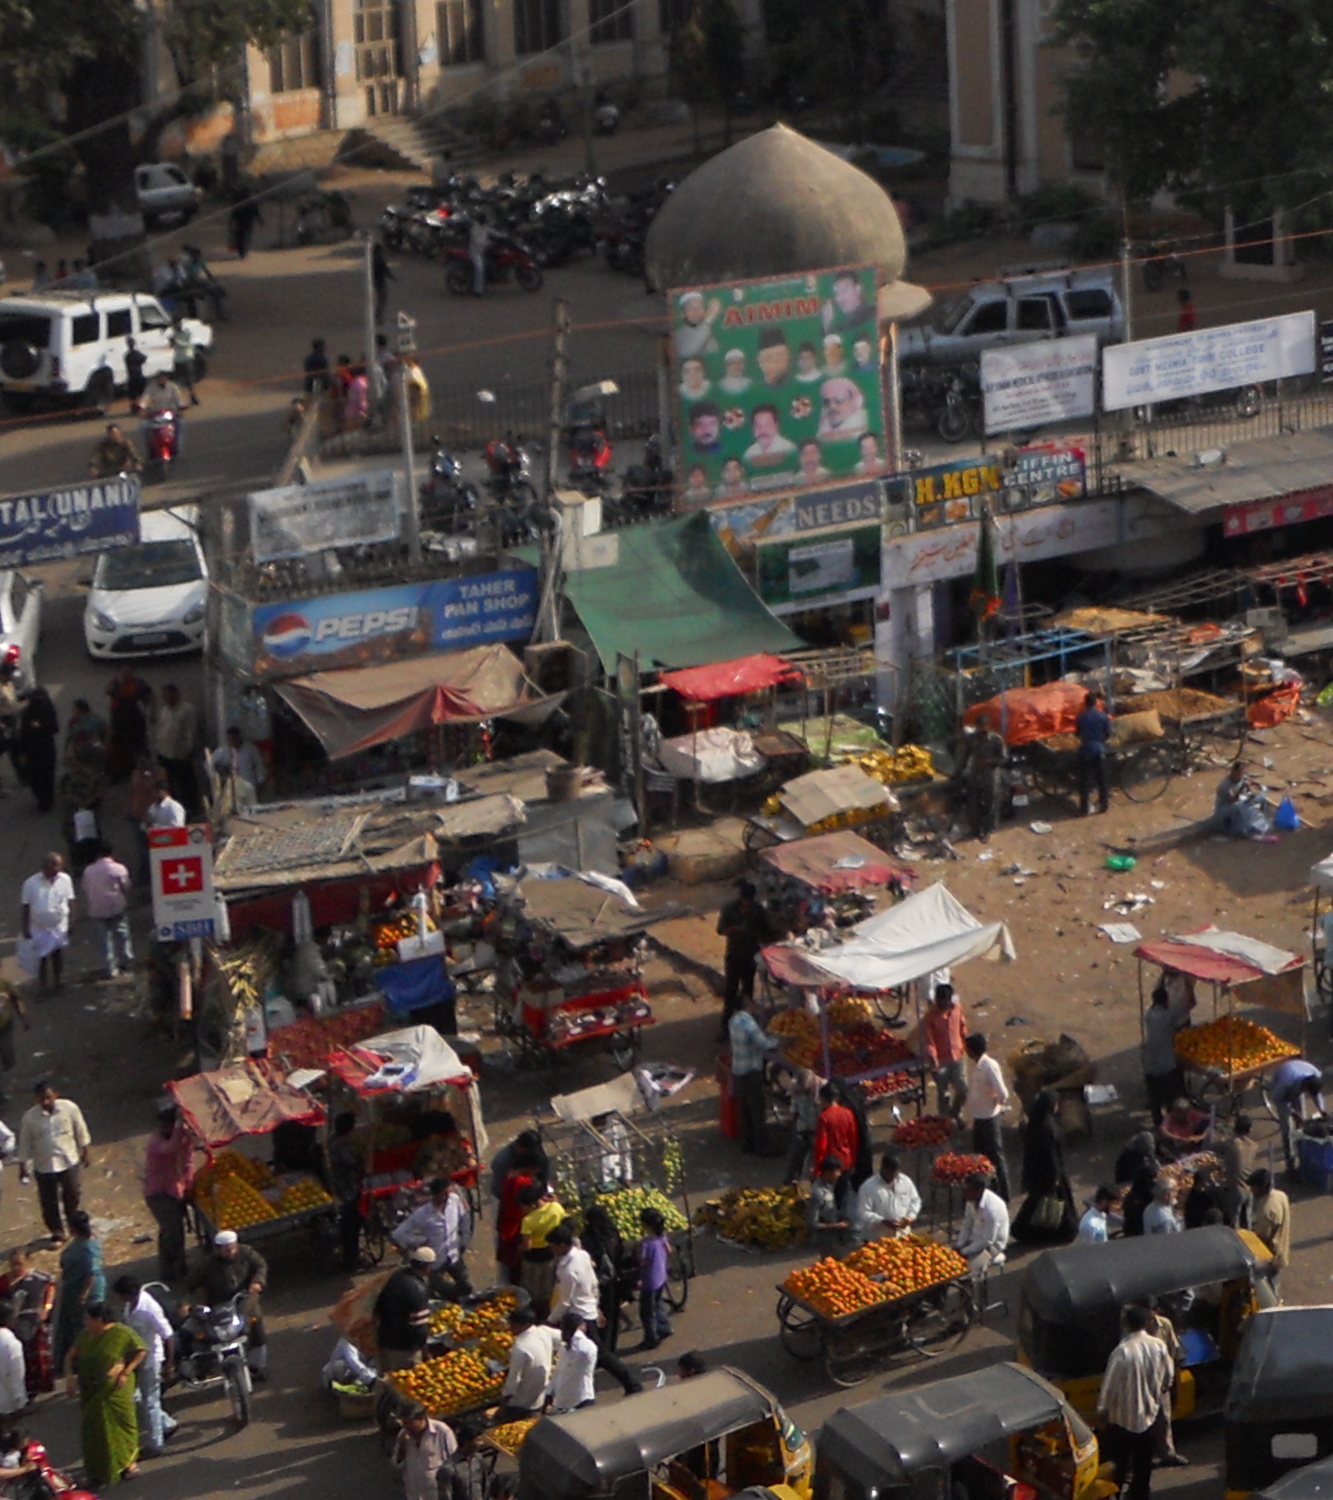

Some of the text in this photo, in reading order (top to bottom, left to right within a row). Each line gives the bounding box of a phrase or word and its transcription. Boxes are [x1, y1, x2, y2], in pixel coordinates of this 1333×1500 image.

[722, 295, 820, 328] AIMIM
[915, 466, 1000, 505] H.KGN
[1003, 463, 1080, 487] CENTRE
[799, 497, 875, 529] NEEDS
[459, 579, 516, 599] TAHER
[444, 593, 529, 619] PAN SHOP
[315, 605, 419, 642] PEPSI
